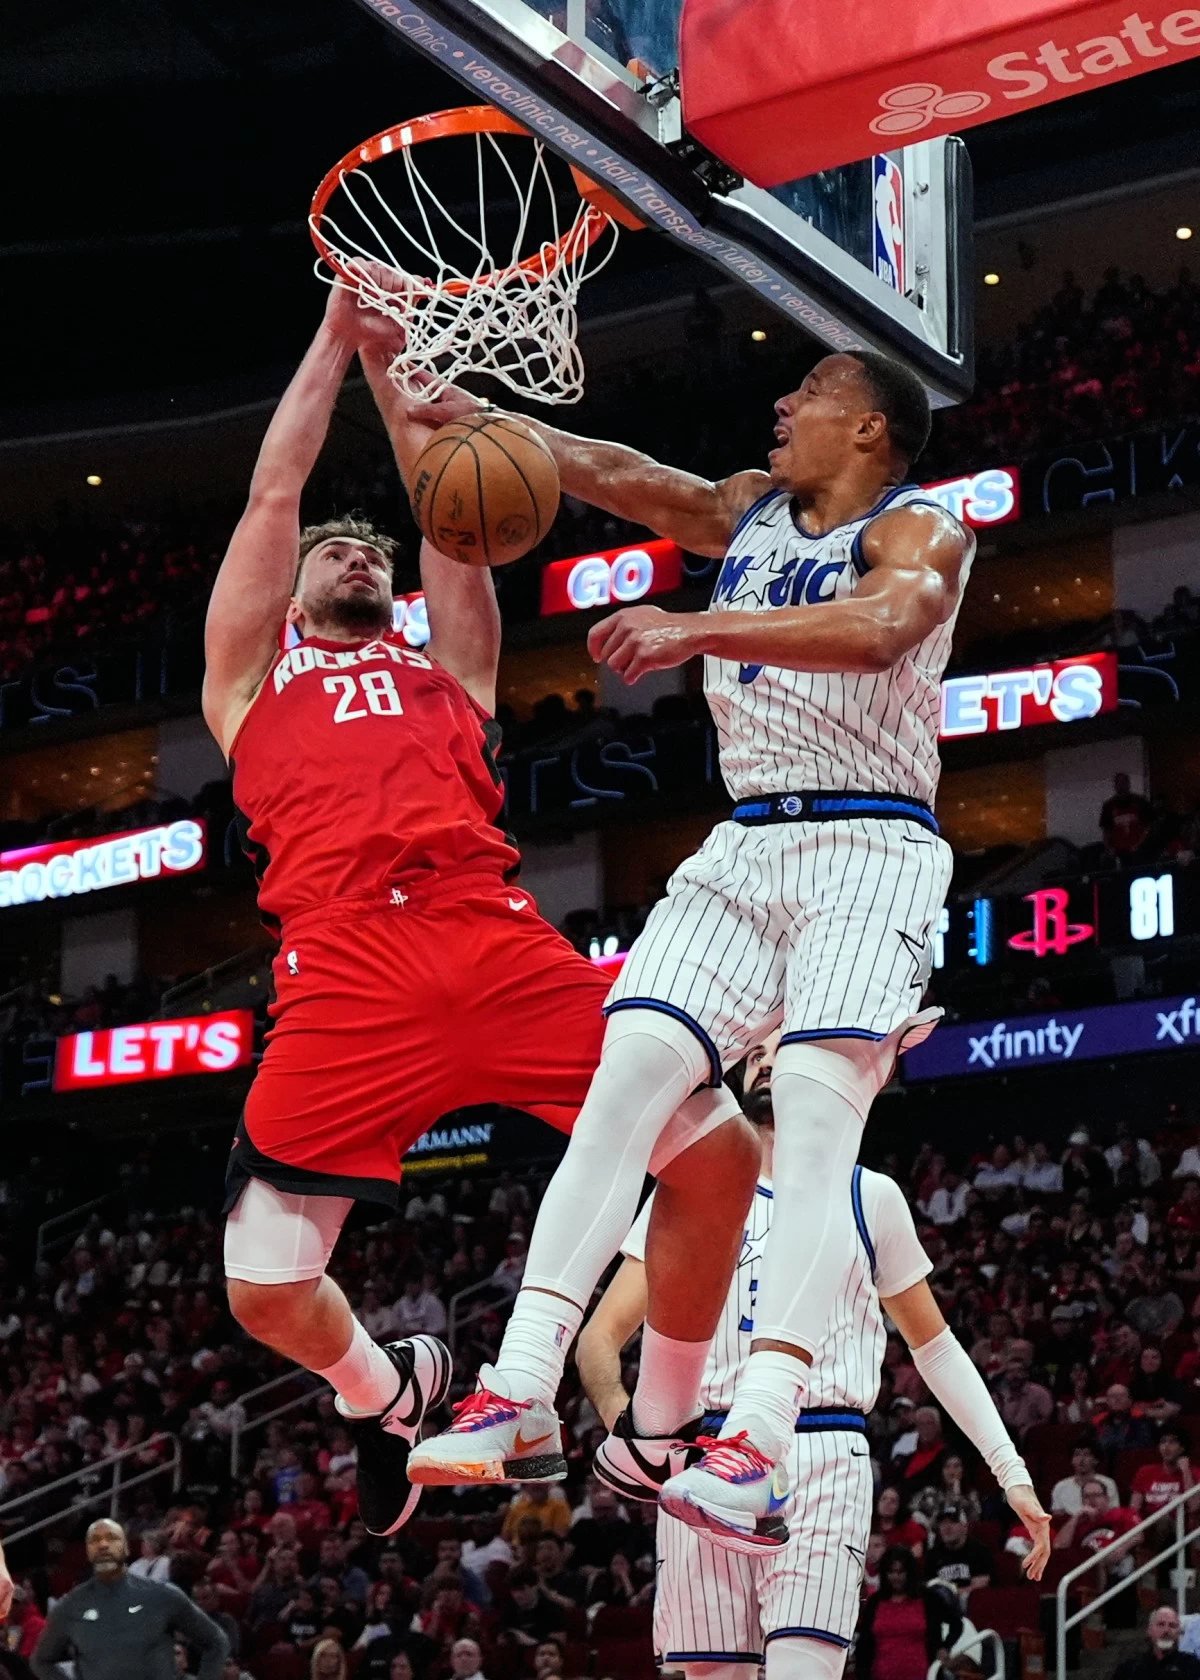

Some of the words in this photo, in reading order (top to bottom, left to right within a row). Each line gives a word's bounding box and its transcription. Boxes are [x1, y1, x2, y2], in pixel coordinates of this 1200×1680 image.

[986, 9, 1200, 100] State
[397, 14, 449, 52] Clinic
[463, 60, 589, 150] veraclinic.net
[593, 156, 639, 184] Hair
[633, 182, 723, 250] Transplant
[717, 247, 773, 283] Turkey
[567, 550, 654, 609] GO
[273, 640, 433, 695] ROCKETS
[322, 670, 404, 724] 28
[940, 665, 1102, 736] ET'S
[1129, 874, 1174, 940] 81
[72, 1021, 241, 1077] LET'S
[967, 1018, 1084, 1068] xfinity
